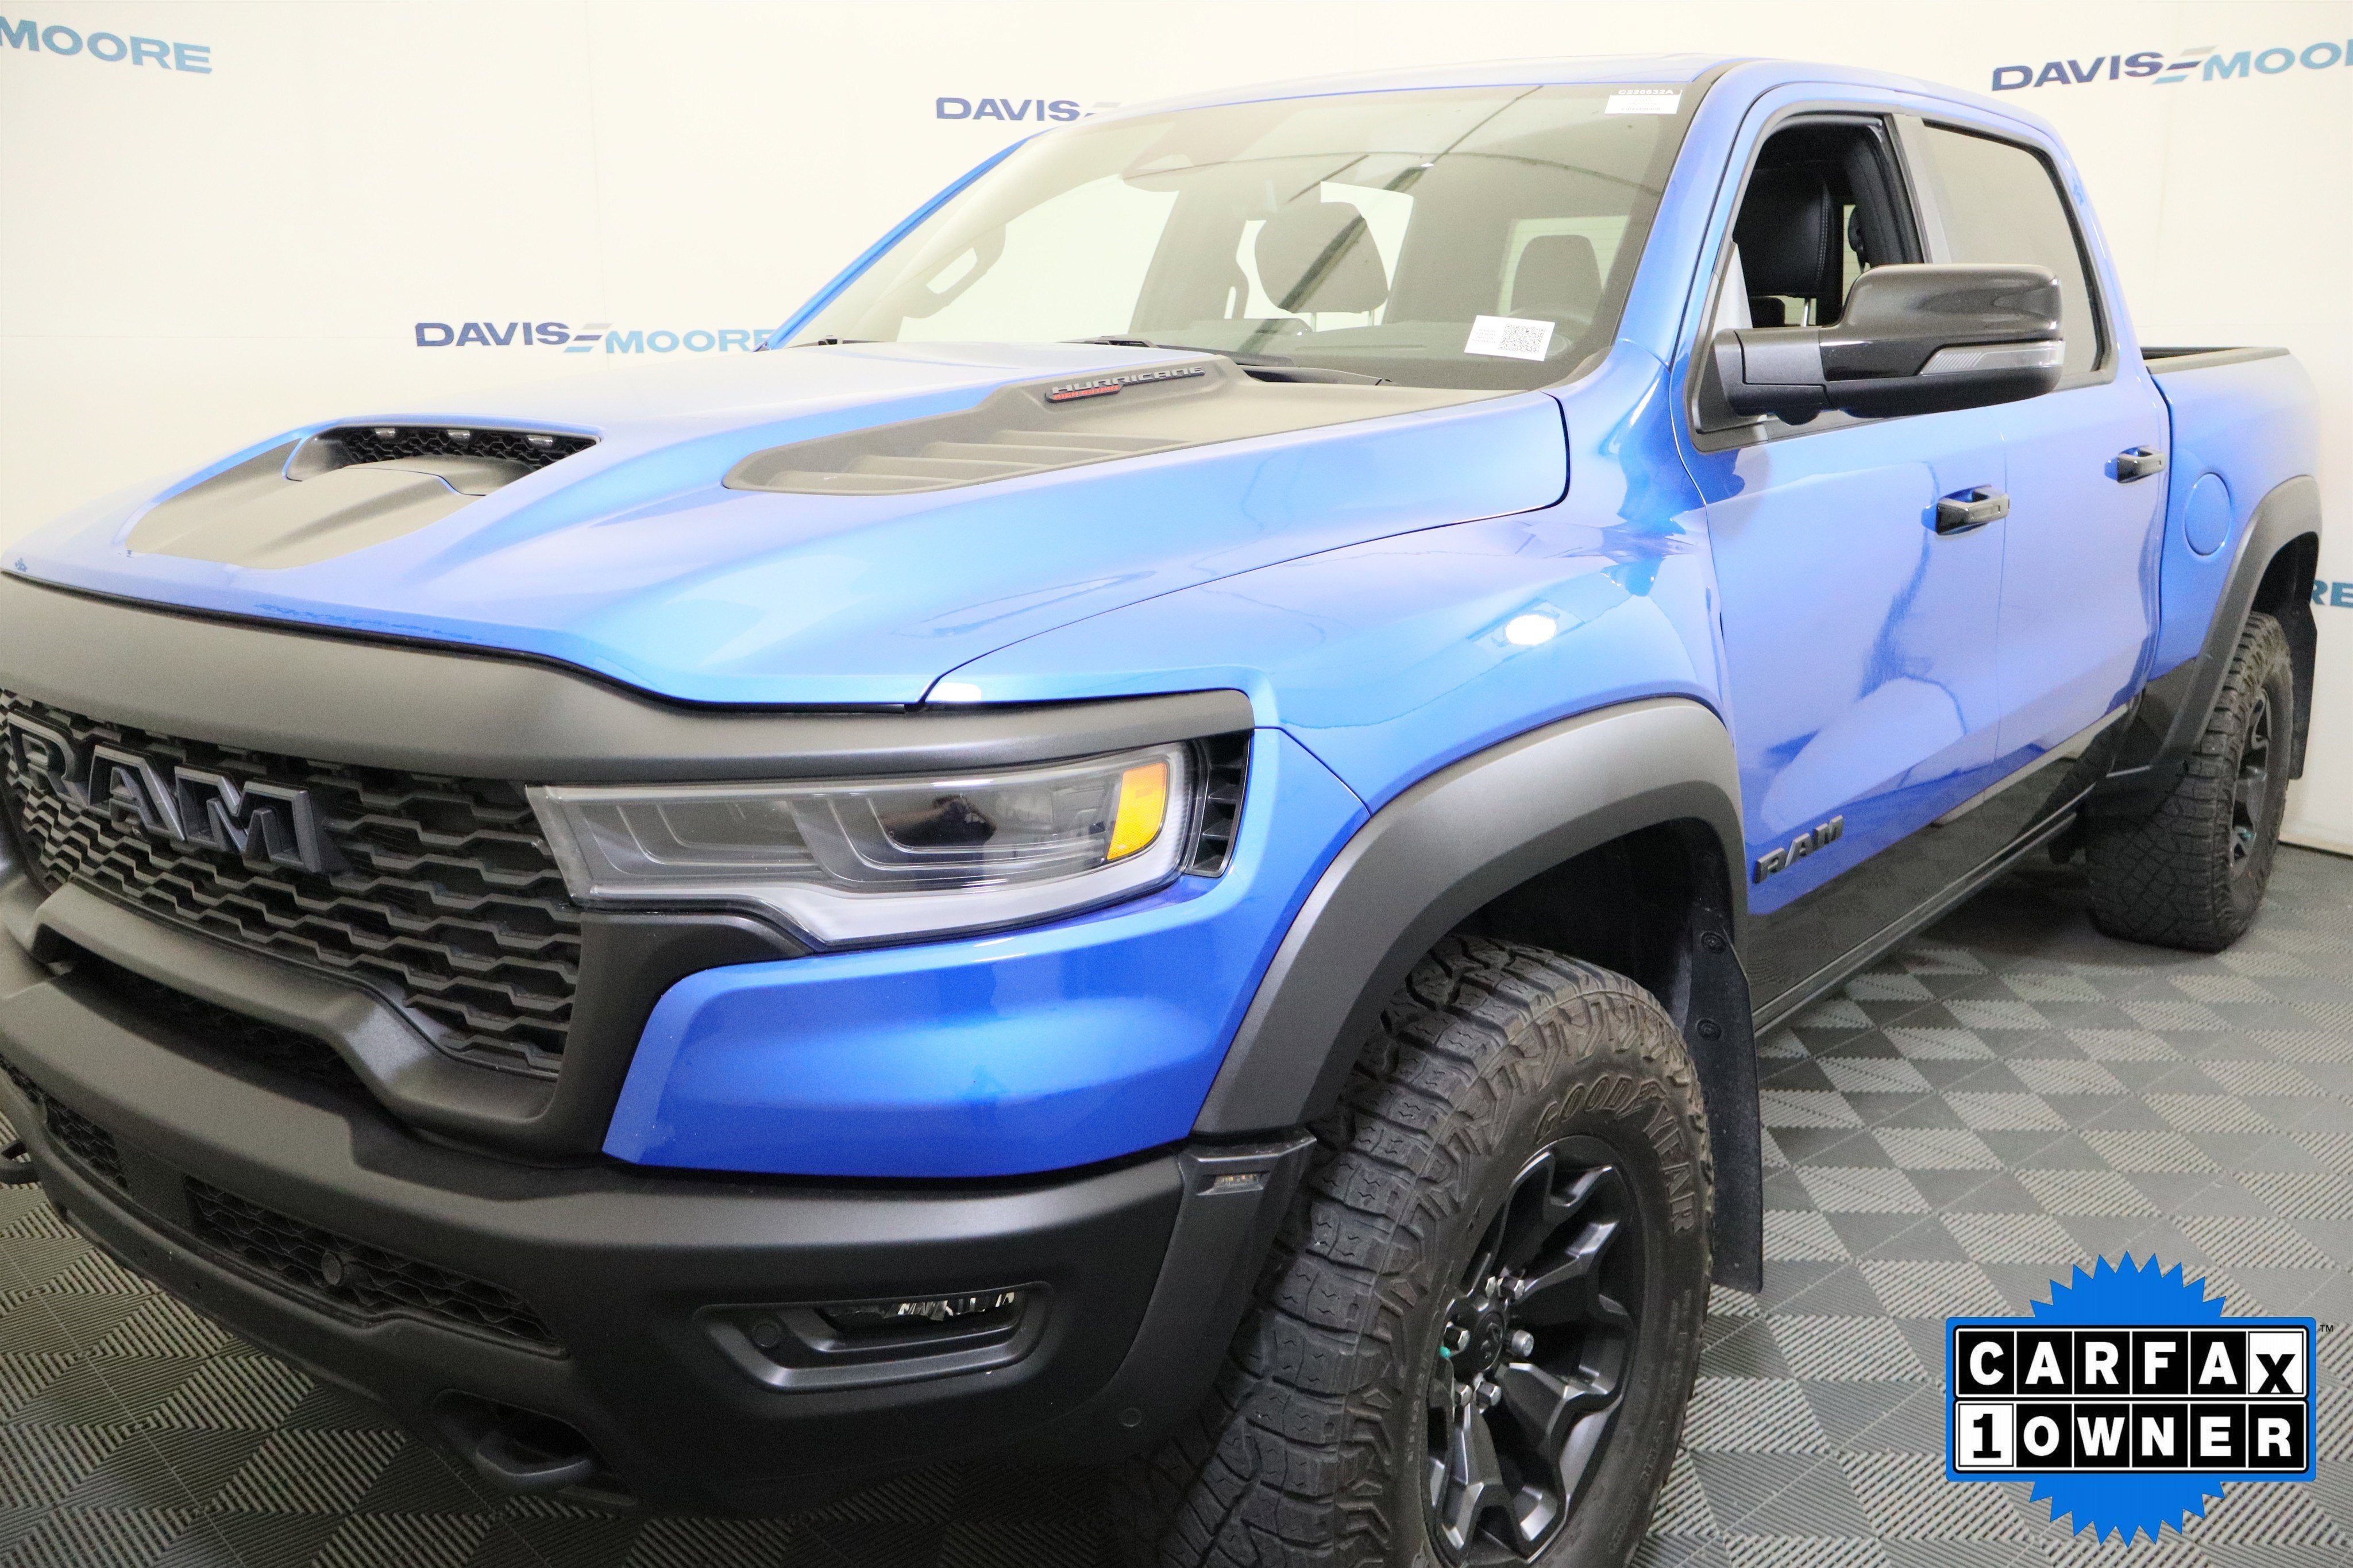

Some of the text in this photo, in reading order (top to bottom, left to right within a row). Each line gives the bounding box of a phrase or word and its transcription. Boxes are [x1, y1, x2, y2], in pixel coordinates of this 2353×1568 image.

[0, 16, 212, 74] MOORE
[1992, 38, 2353, 91] DAVIS MOO
[936, 97, 1081, 122] DAVIS
[415, 322, 570, 347] DAVIS
[1052, 366, 1204, 395] HURRICANE
[1054, 385, 1119, 400] HIGH OUTPUT
[6, 709, 323, 873] RAM
[1752, 815, 1843, 884] RAM
